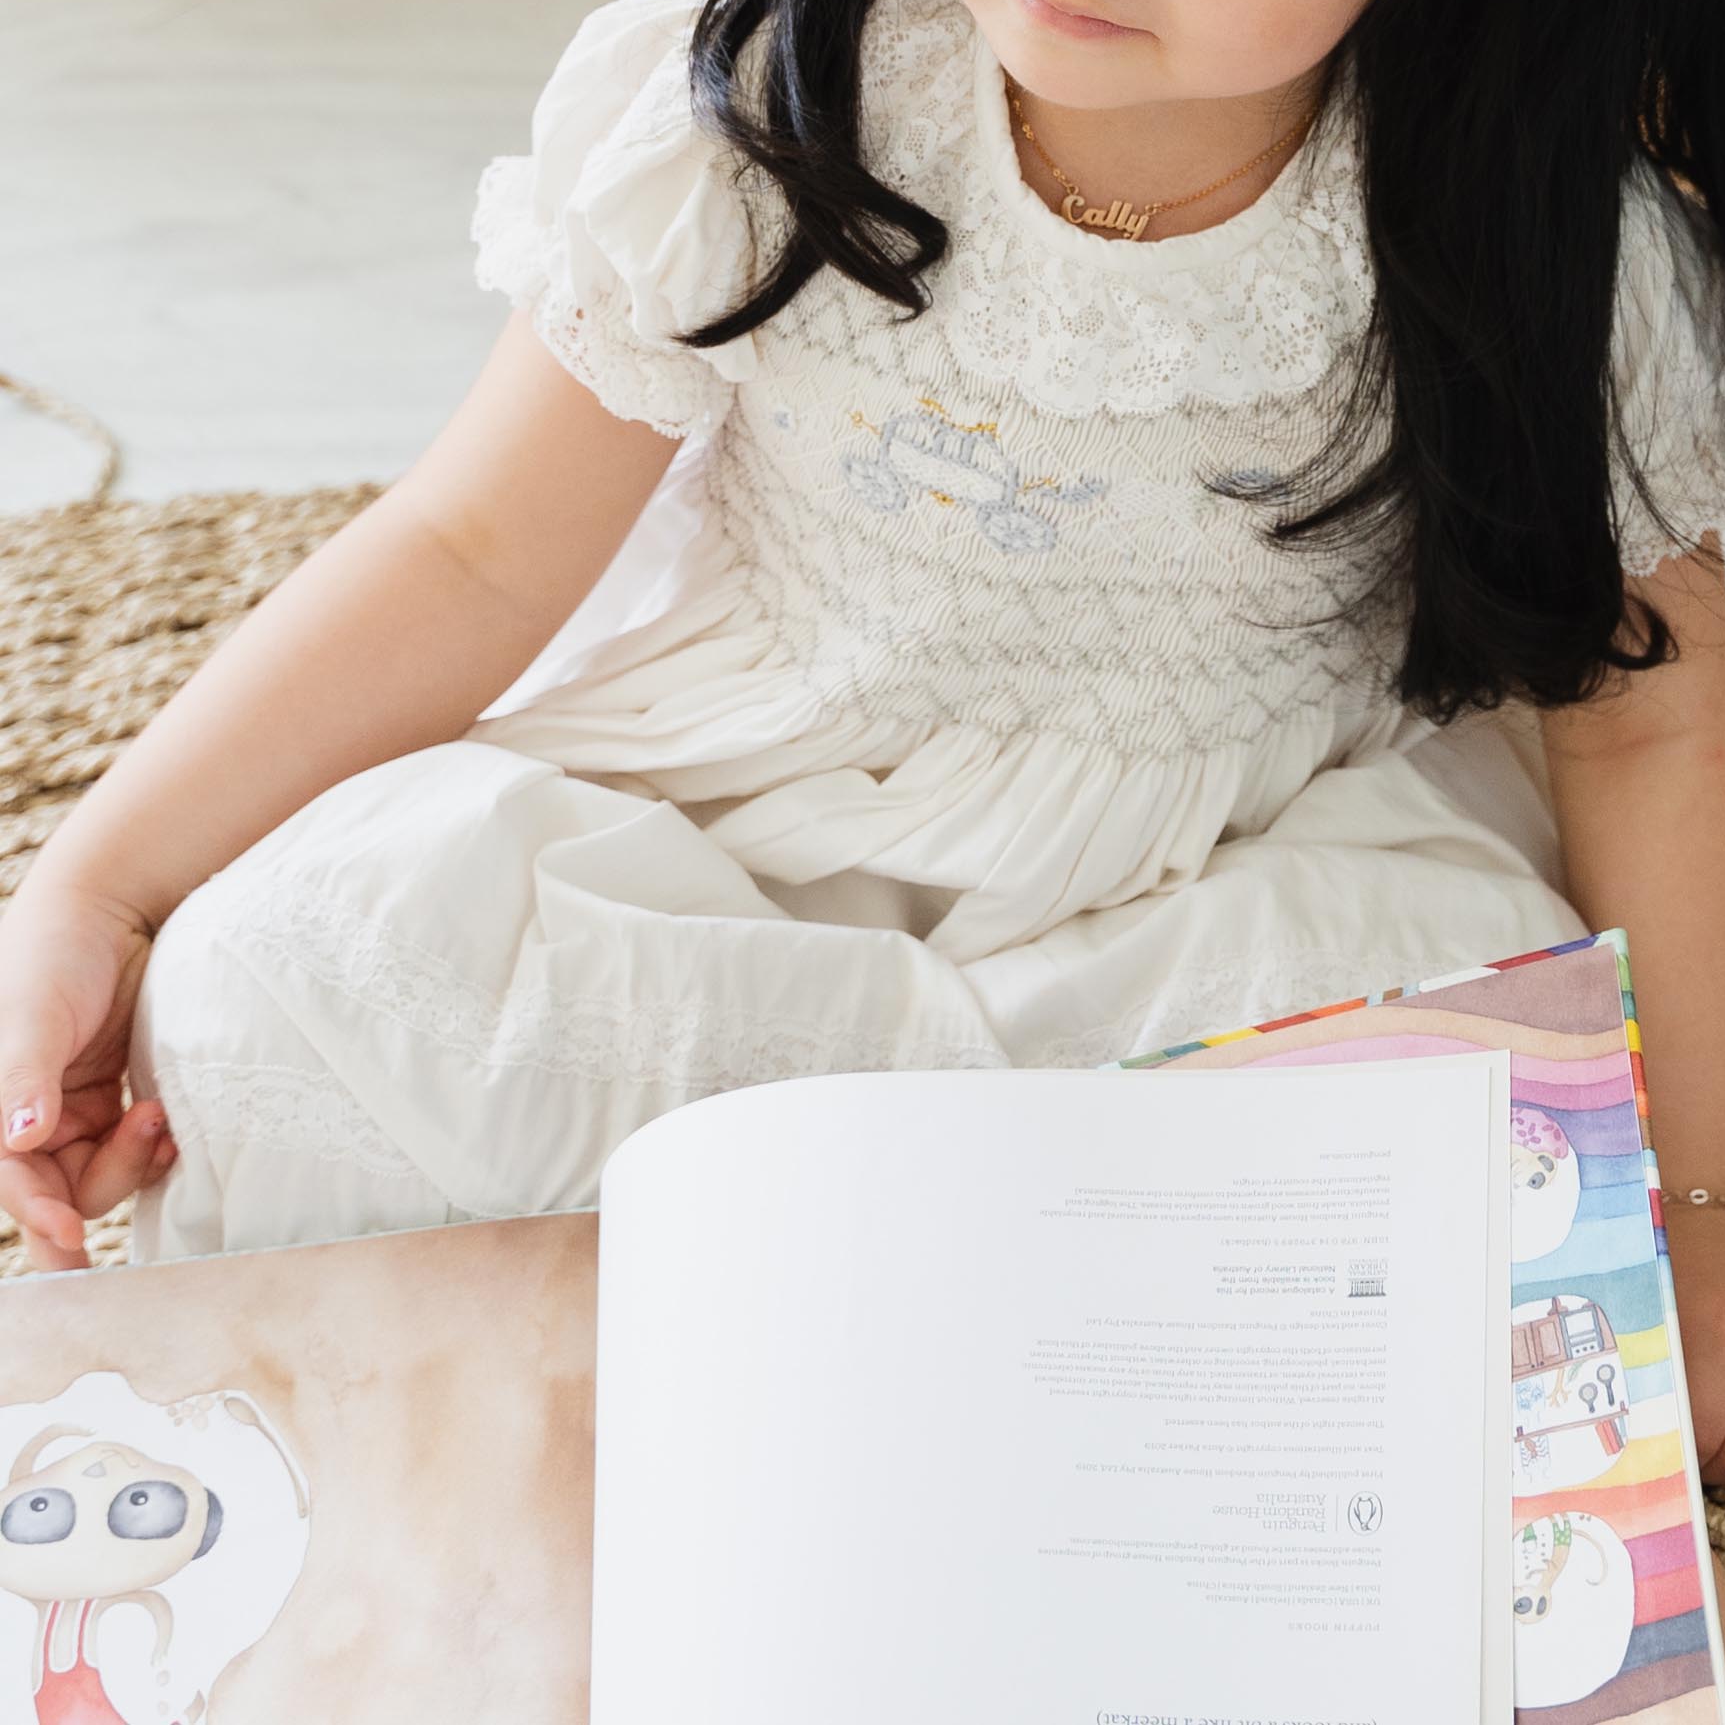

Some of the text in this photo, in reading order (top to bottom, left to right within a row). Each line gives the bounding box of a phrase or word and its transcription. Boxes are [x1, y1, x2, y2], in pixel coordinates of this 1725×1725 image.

[1061, 193, 1150, 242] Cally
[1255, 1492, 1327, 1505] Australia
[1212, 1505, 1326, 1519] Random House
[1261, 1519, 1326, 1532] Penguin
